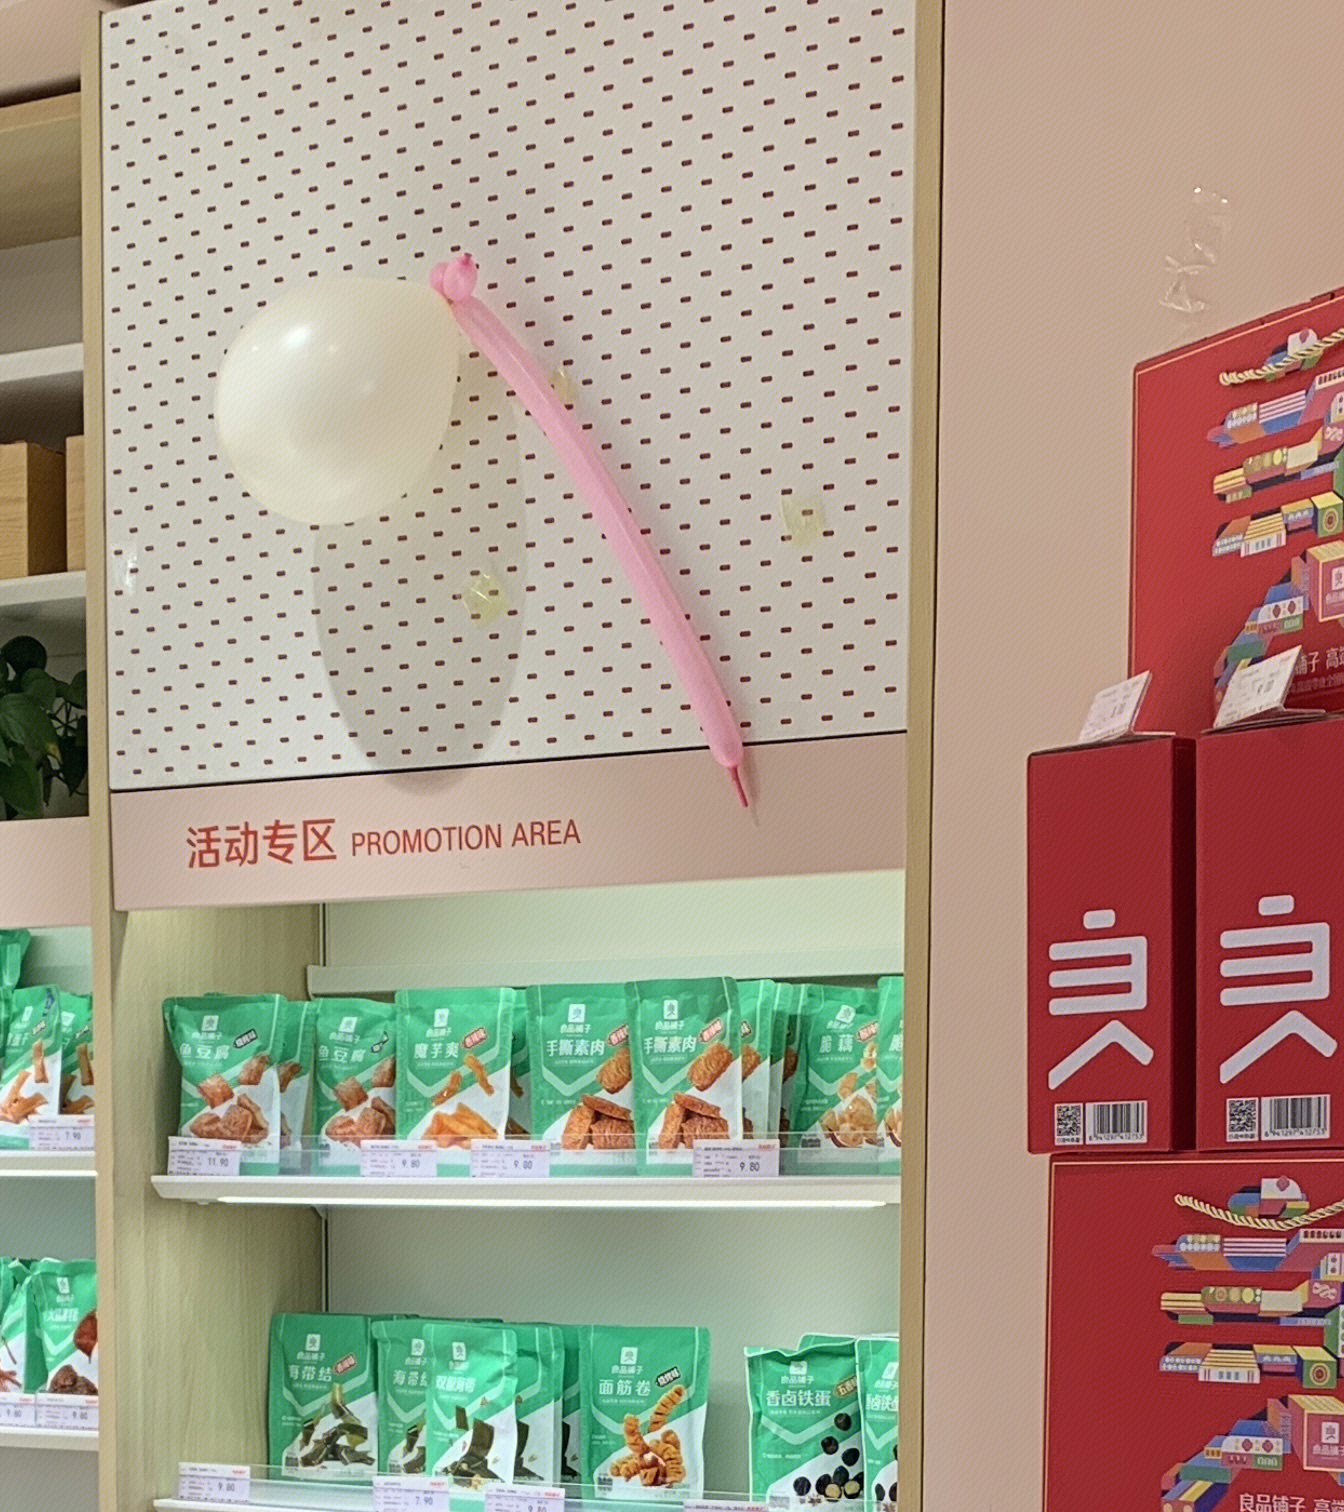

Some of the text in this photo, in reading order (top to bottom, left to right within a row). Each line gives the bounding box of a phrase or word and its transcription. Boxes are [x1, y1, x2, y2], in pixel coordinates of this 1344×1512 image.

[185, 817, 581, 869] 活动专区 PROMOTION AREA
[414, 1043, 459, 1059] 魔芋爽
[546, 1039, 605, 1057] 手撕素肉
[643, 1036, 697, 1053] 手撕素肉
[819, 1034, 853, 1053] 脆藕
[739, 1161, 760, 1172] 9.80
[599, 1379, 651, 1396] 面筋卷
[766, 1390, 831, 1407] 香卤铁蛋
[415, 1496, 433, 1506] 7.90
